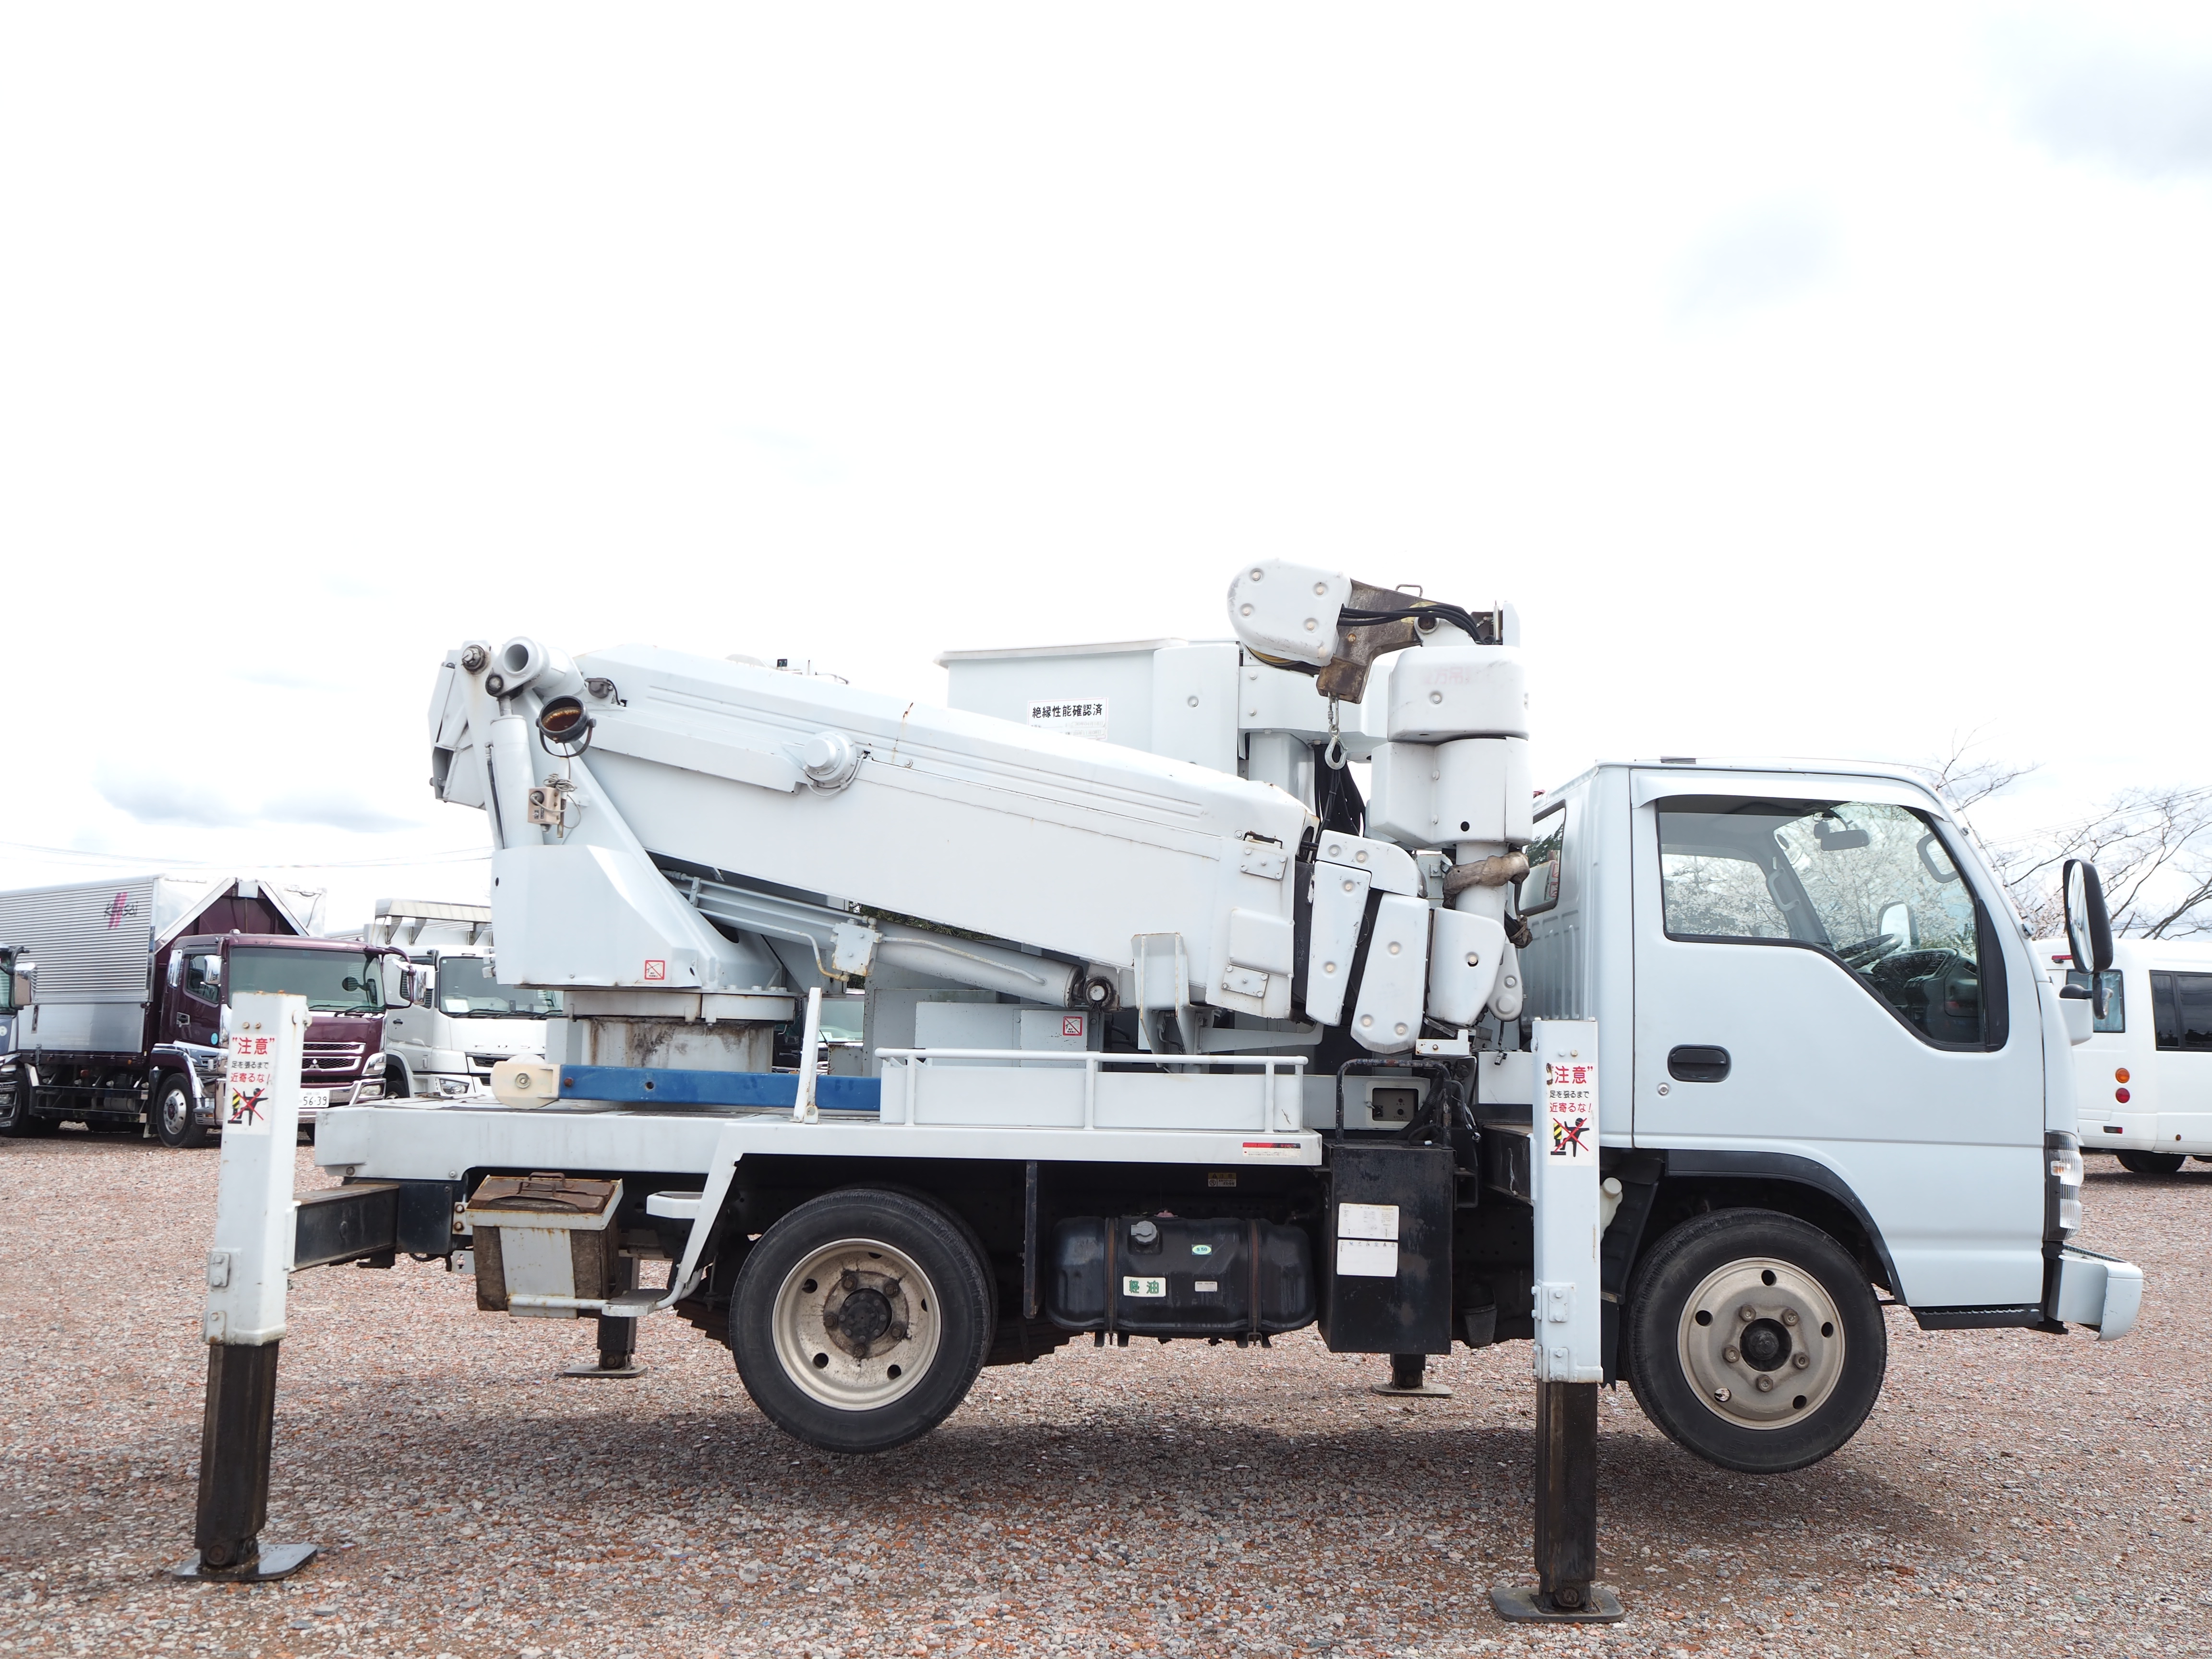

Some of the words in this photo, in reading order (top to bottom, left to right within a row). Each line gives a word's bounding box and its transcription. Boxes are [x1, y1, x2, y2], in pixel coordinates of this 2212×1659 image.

[1032, 703, 1103, 719] 絶縁性能確認済
[231, 1061, 269, 1070] 足を張るまで
[1550, 1090, 1589, 1098] 足を張るまで
[1129, 1279, 1159, 1294] 軽油
